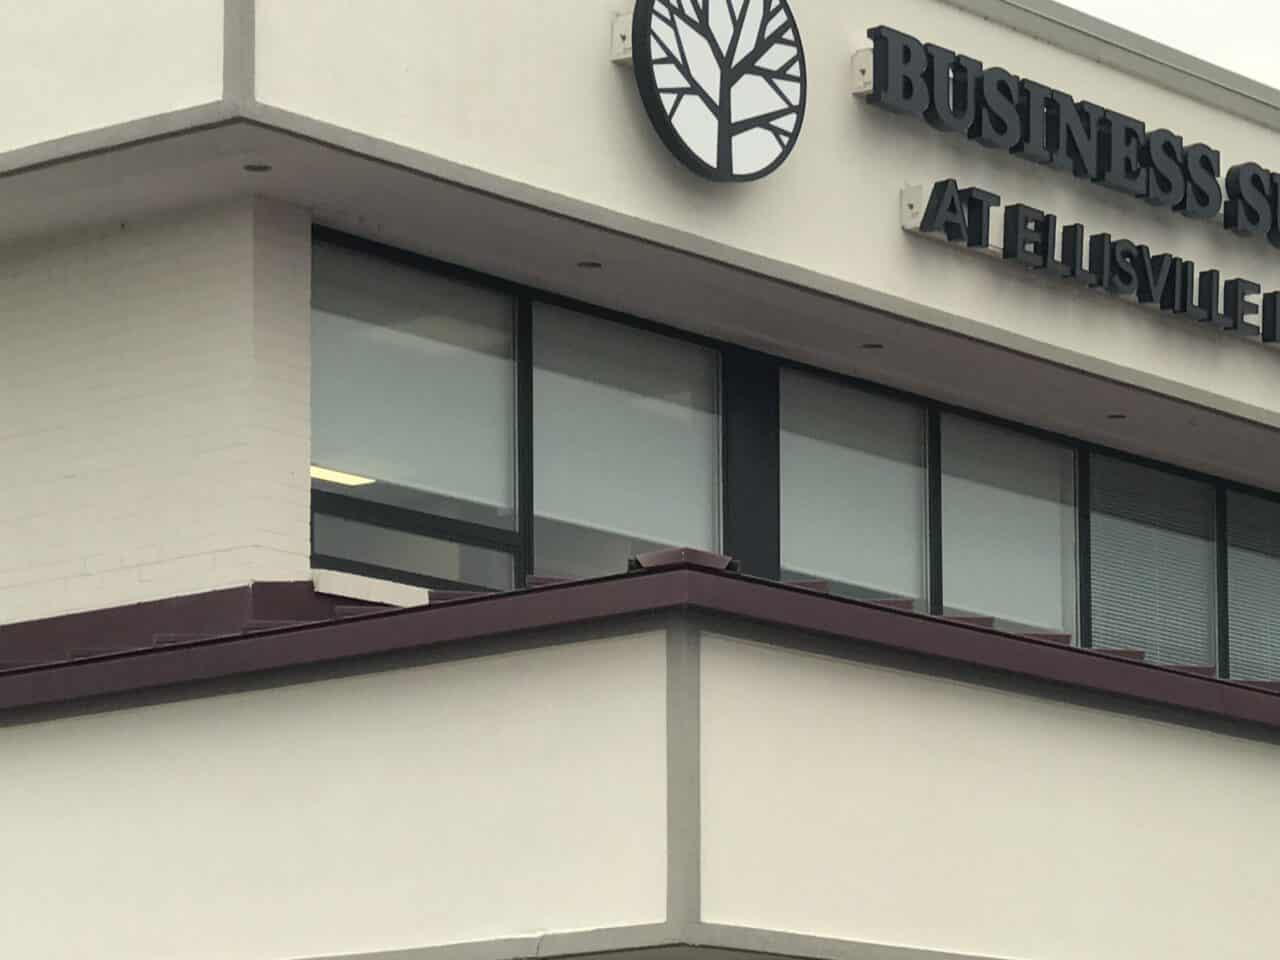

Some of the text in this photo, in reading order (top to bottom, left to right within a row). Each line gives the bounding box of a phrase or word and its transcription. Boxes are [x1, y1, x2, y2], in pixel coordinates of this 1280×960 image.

[867, 25, 1221, 218] BUSINESS
[920, 178, 1001, 248] AT
[1003, 202, 1261, 338] ELLISVILLE
